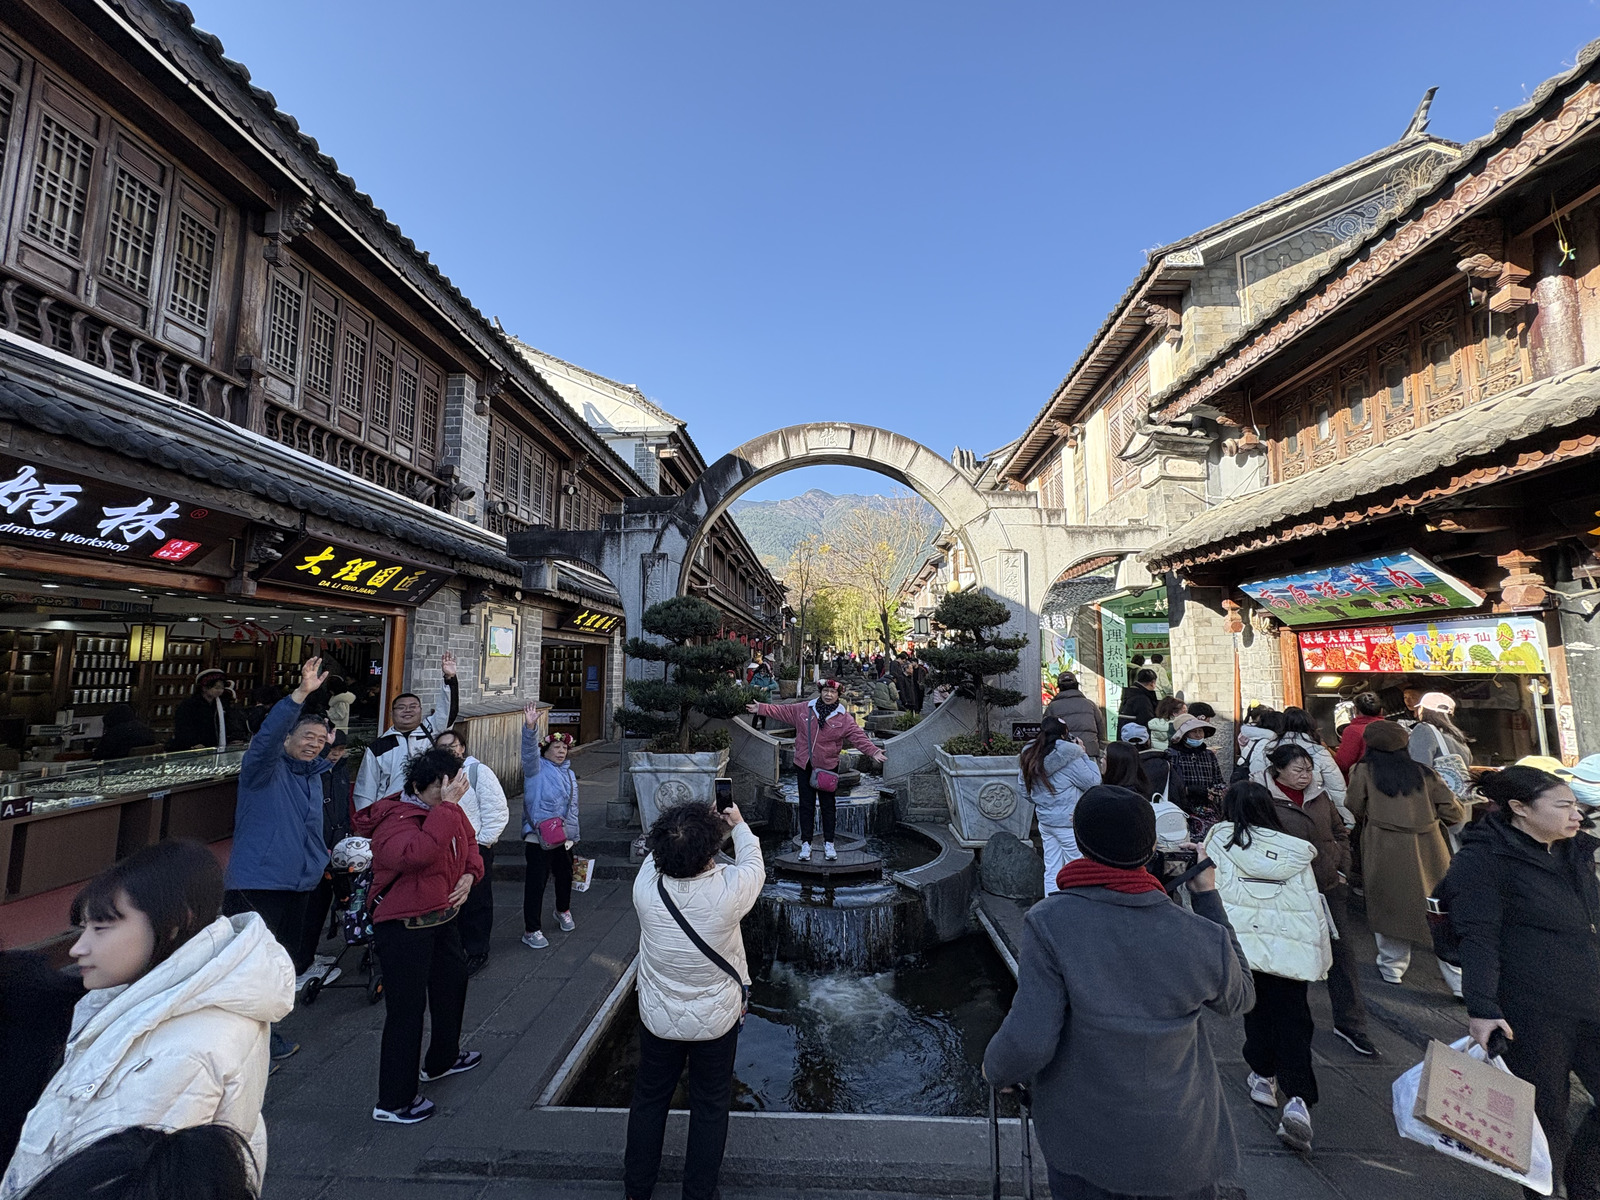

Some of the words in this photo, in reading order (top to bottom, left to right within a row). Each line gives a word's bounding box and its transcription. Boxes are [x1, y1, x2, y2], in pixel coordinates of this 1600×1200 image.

[60, 532, 130, 553] Workshop
[318, 579, 331, 587] DA
[1259, 564, 1426, 610] 高原牦牛肉
[3, 800, 32, 817] A-1
